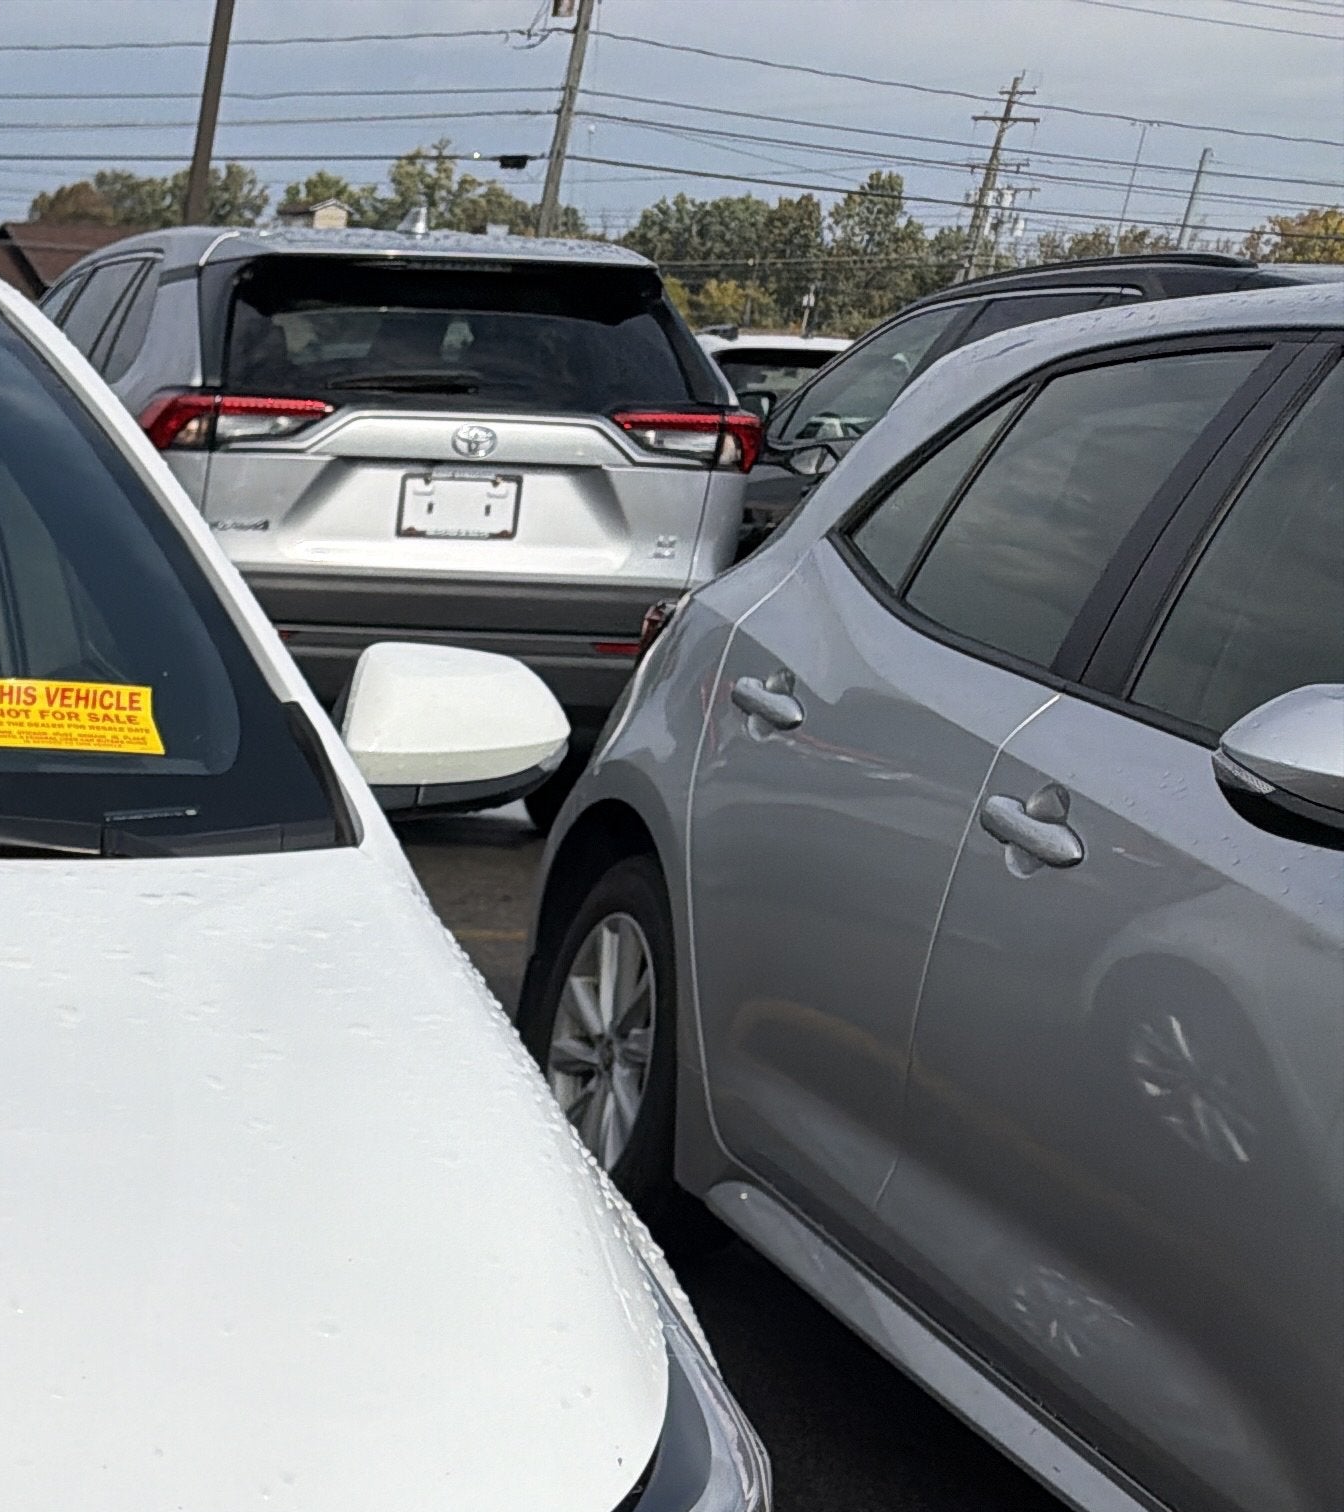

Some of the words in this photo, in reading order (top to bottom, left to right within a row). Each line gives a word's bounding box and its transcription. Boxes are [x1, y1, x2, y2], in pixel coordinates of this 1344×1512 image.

[45, 687, 142, 711] VEHICLE
[40, 710, 81, 722] FOR
[88, 713, 138, 725] SALE
